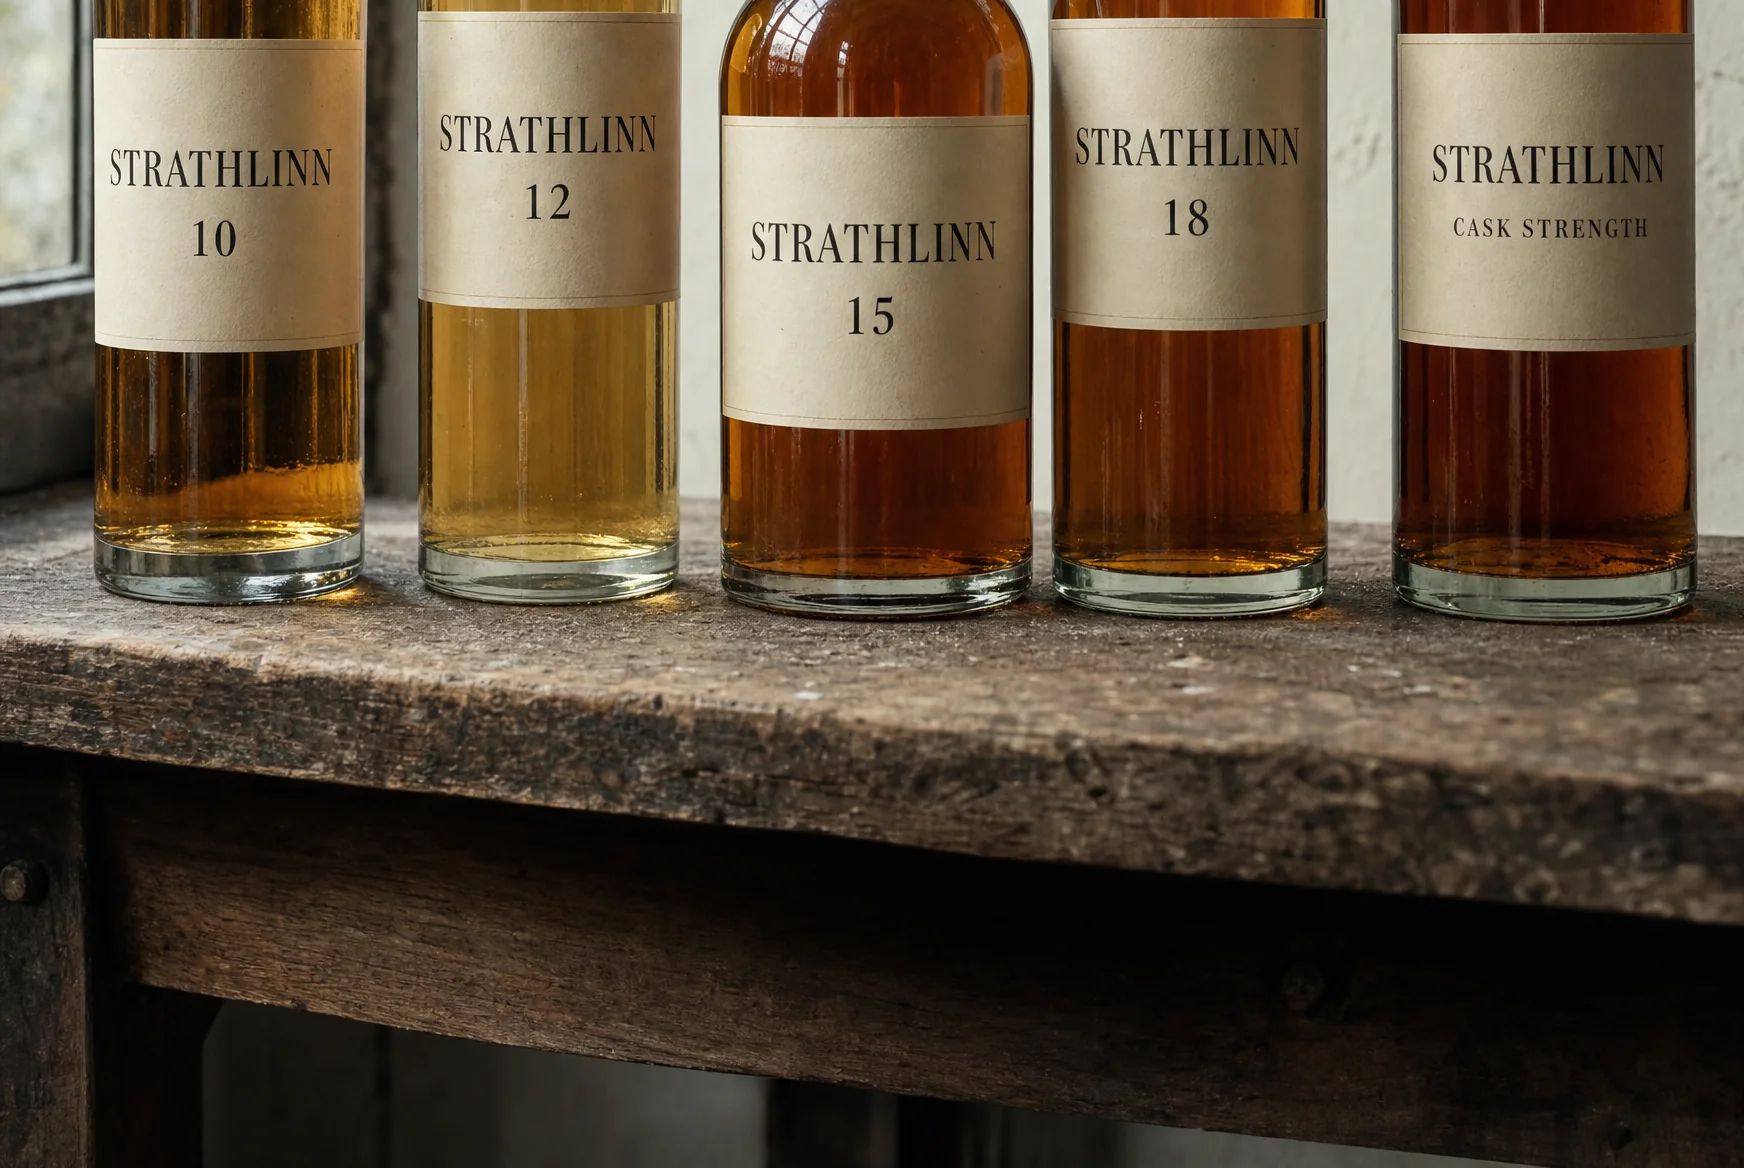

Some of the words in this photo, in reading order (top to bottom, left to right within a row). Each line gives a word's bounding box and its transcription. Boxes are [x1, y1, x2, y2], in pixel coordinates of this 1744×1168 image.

[439, 113, 657, 154] STRATHLINN
[1075, 126, 1299, 167] STRATHLINN
[109, 148, 333, 188] STRATHLINN
[1432, 143, 1664, 184] STRATHLINN
[525, 183, 571, 220] 12
[1164, 198, 1209, 237] 18
[192, 219, 237, 258] 10
[751, 220, 997, 264] STRATHLINN
[1453, 216, 1512, 238] CASK
[1522, 218, 1648, 239] STRENGTH
[848, 295, 894, 336] 15
